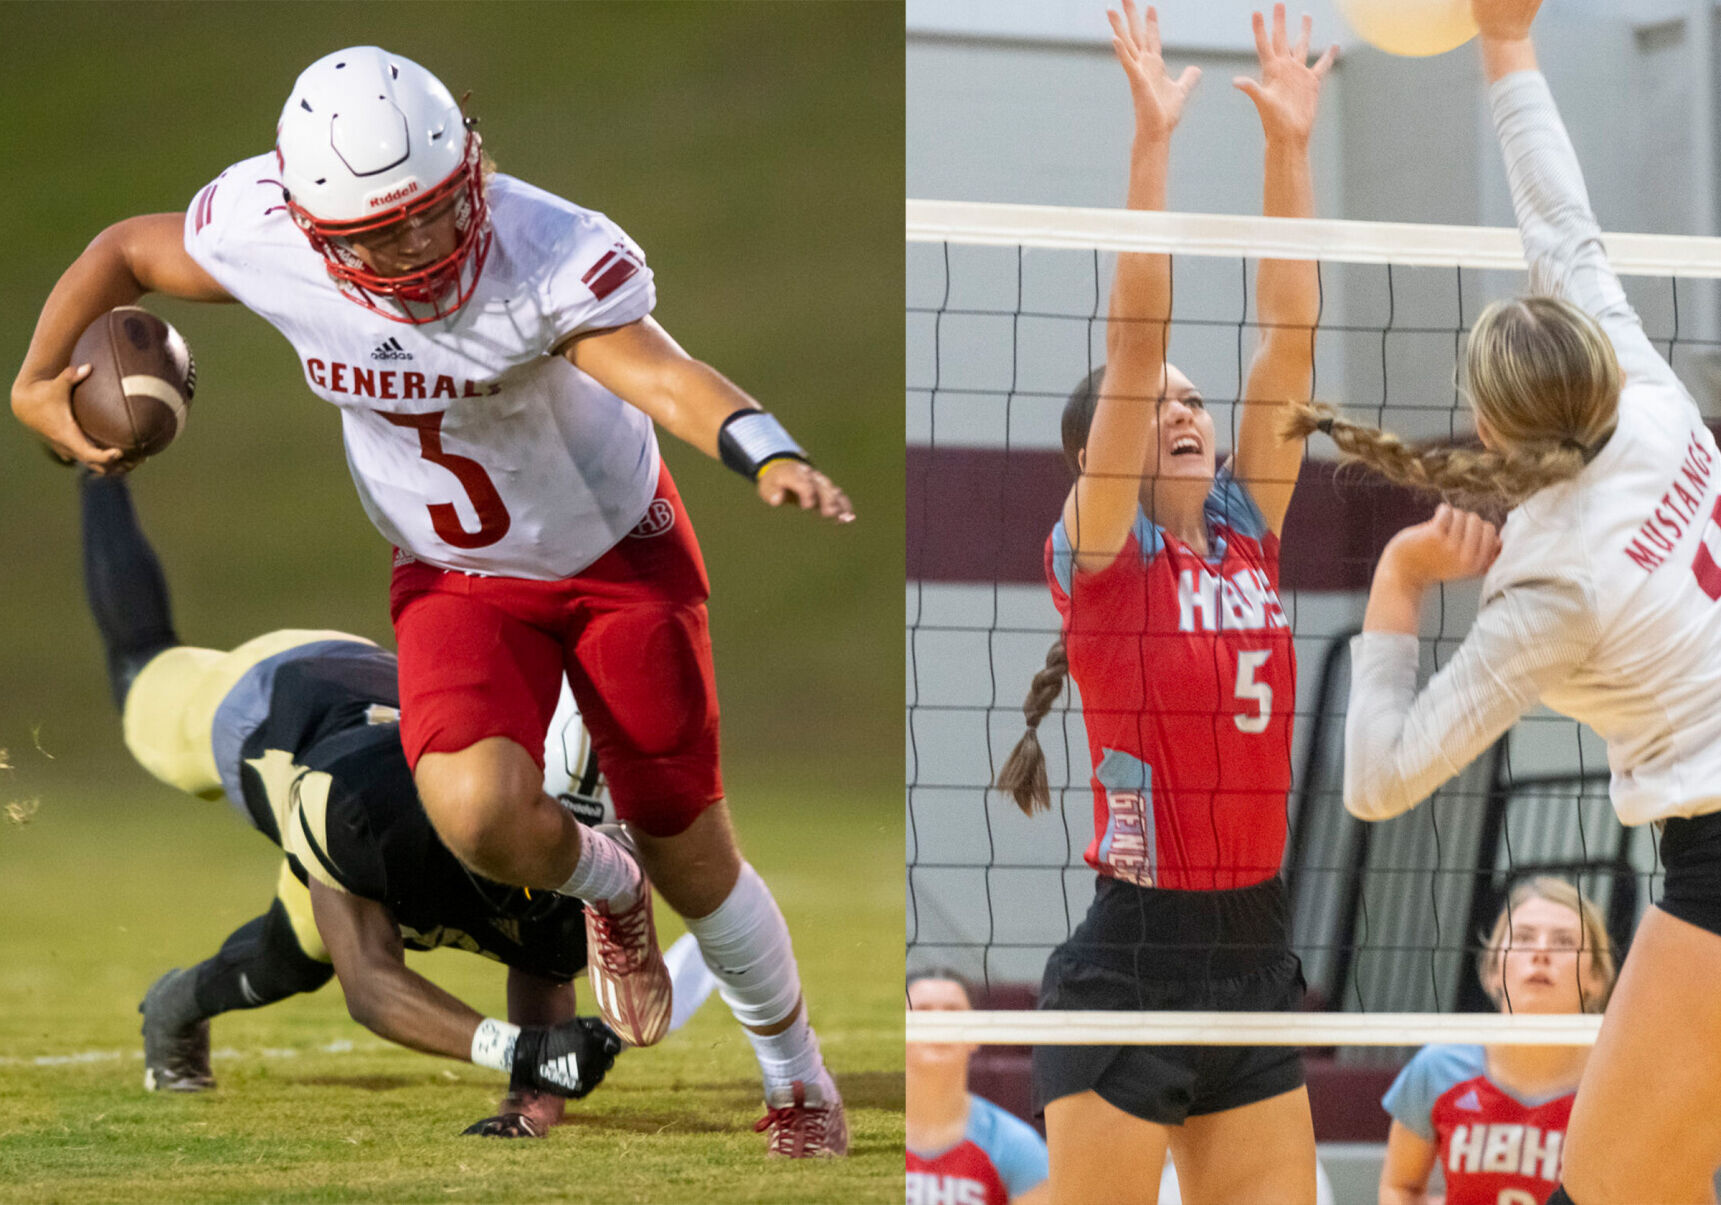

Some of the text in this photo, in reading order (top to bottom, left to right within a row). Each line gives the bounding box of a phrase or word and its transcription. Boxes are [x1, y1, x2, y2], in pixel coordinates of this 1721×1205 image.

[369, 181, 418, 208] Riddell
[371, 352, 414, 361] adidas
[372, 408, 511, 549] 3
[1624, 430, 1712, 573] MUSTANGS
[1233, 649, 1273, 734] 5
